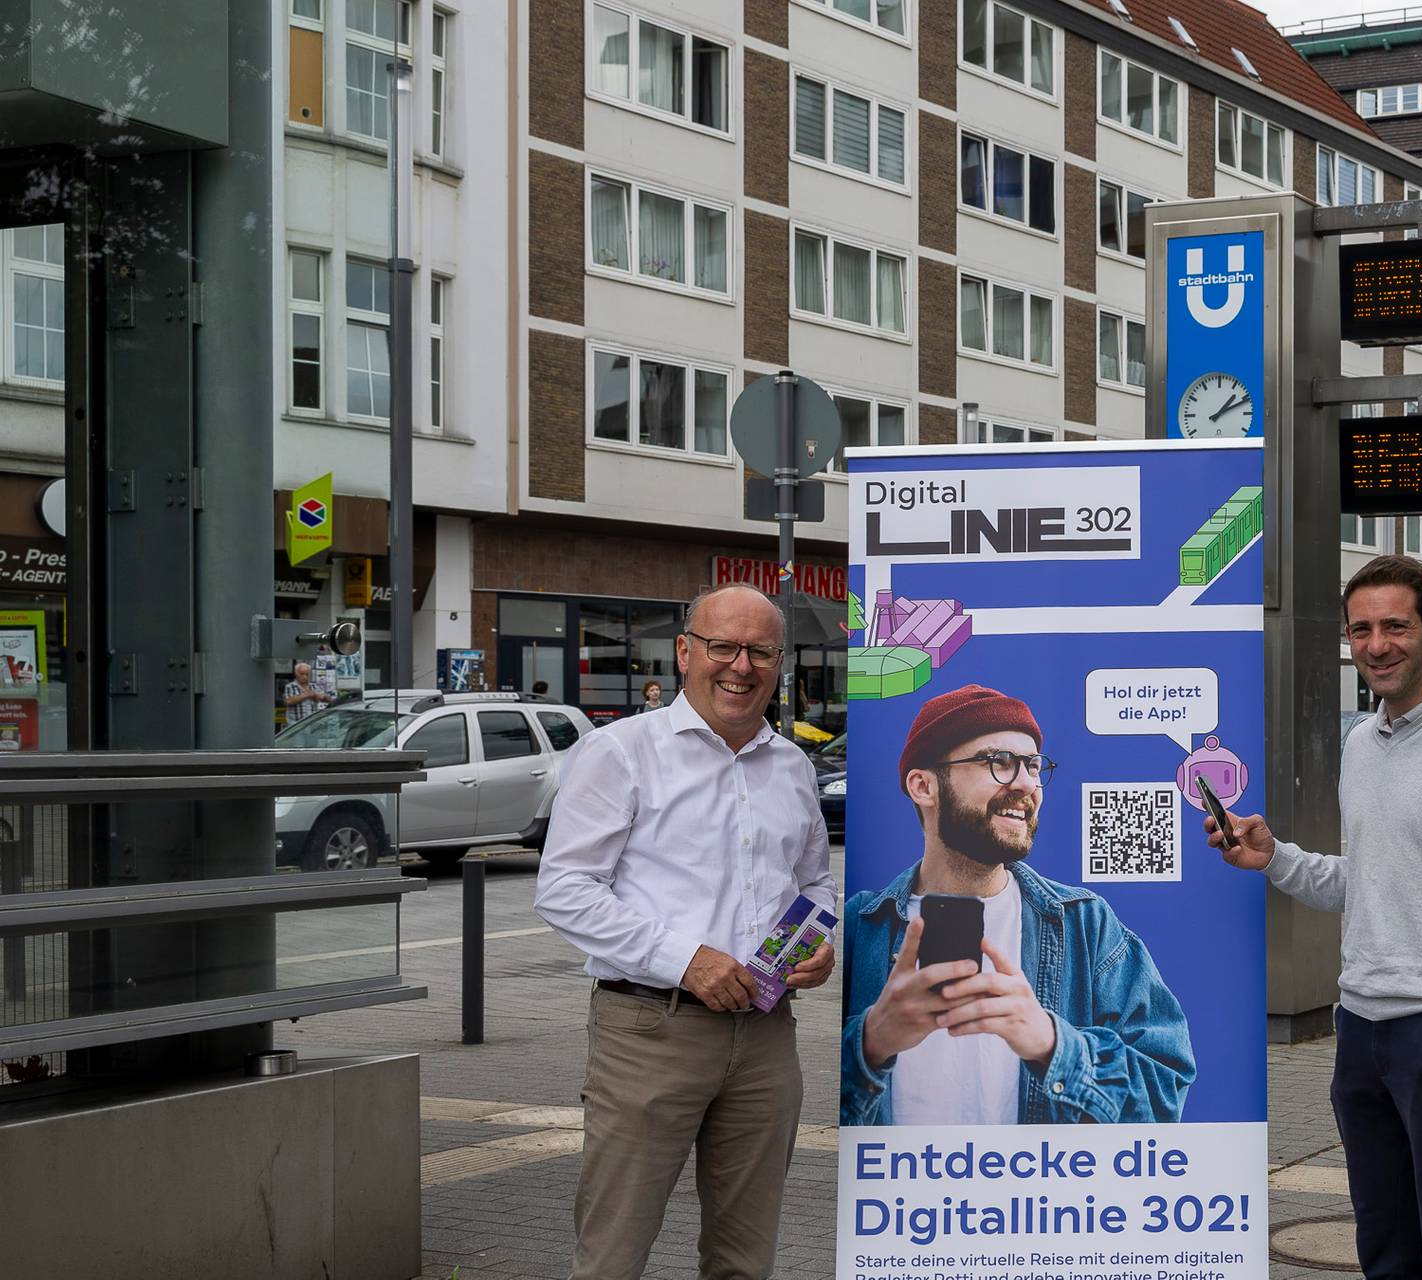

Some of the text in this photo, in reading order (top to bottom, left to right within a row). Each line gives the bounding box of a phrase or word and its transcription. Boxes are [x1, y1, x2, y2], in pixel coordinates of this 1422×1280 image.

[1178, 272, 1254, 287] stadtbahn
[866, 480, 966, 510] Digital
[866, 507, 1132, 556] LINIE 302
[1104, 685, 1201, 701] Hol dir jetzt
[1118, 706, 1186, 721] die App!
[856, 1139, 1189, 1180] Entdecke die
[855, 1194, 1250, 1245] Digitallinie 302!
[855, 1251, 1244, 1268] Starte deine virtuelle Reise mit deinem digitalen
